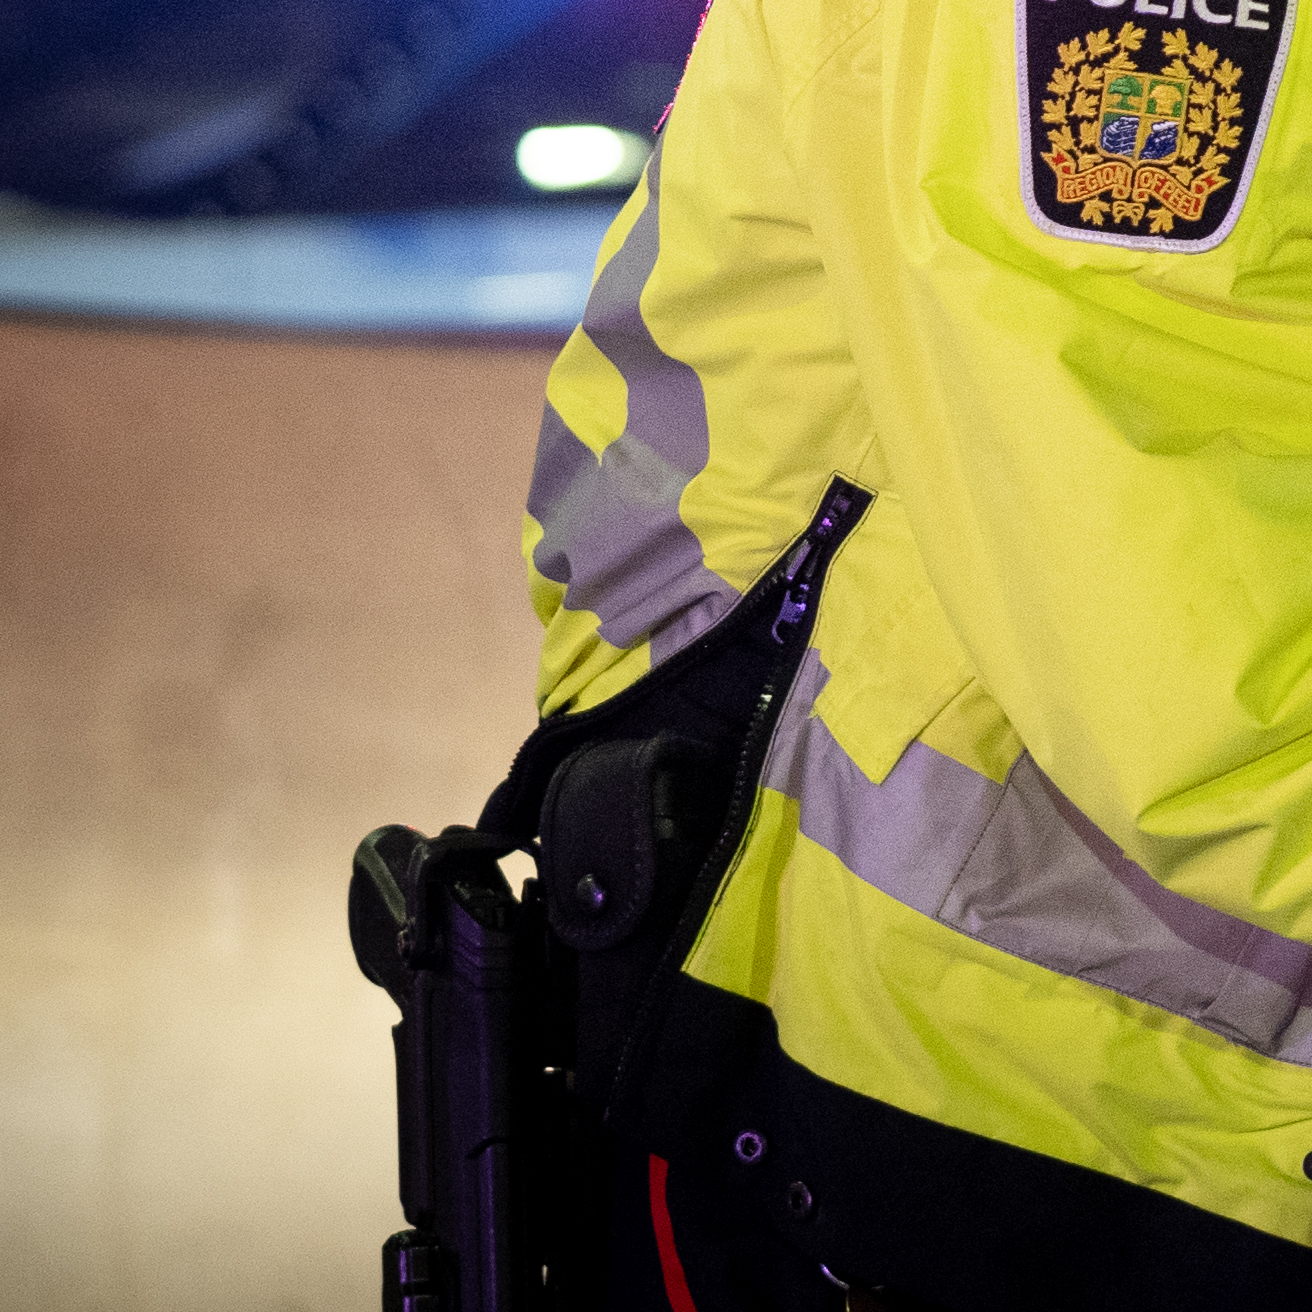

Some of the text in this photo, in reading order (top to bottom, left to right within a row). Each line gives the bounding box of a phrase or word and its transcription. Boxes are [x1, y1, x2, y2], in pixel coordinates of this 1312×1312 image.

[1062, 165, 1202, 216] REGION OF PEEL
